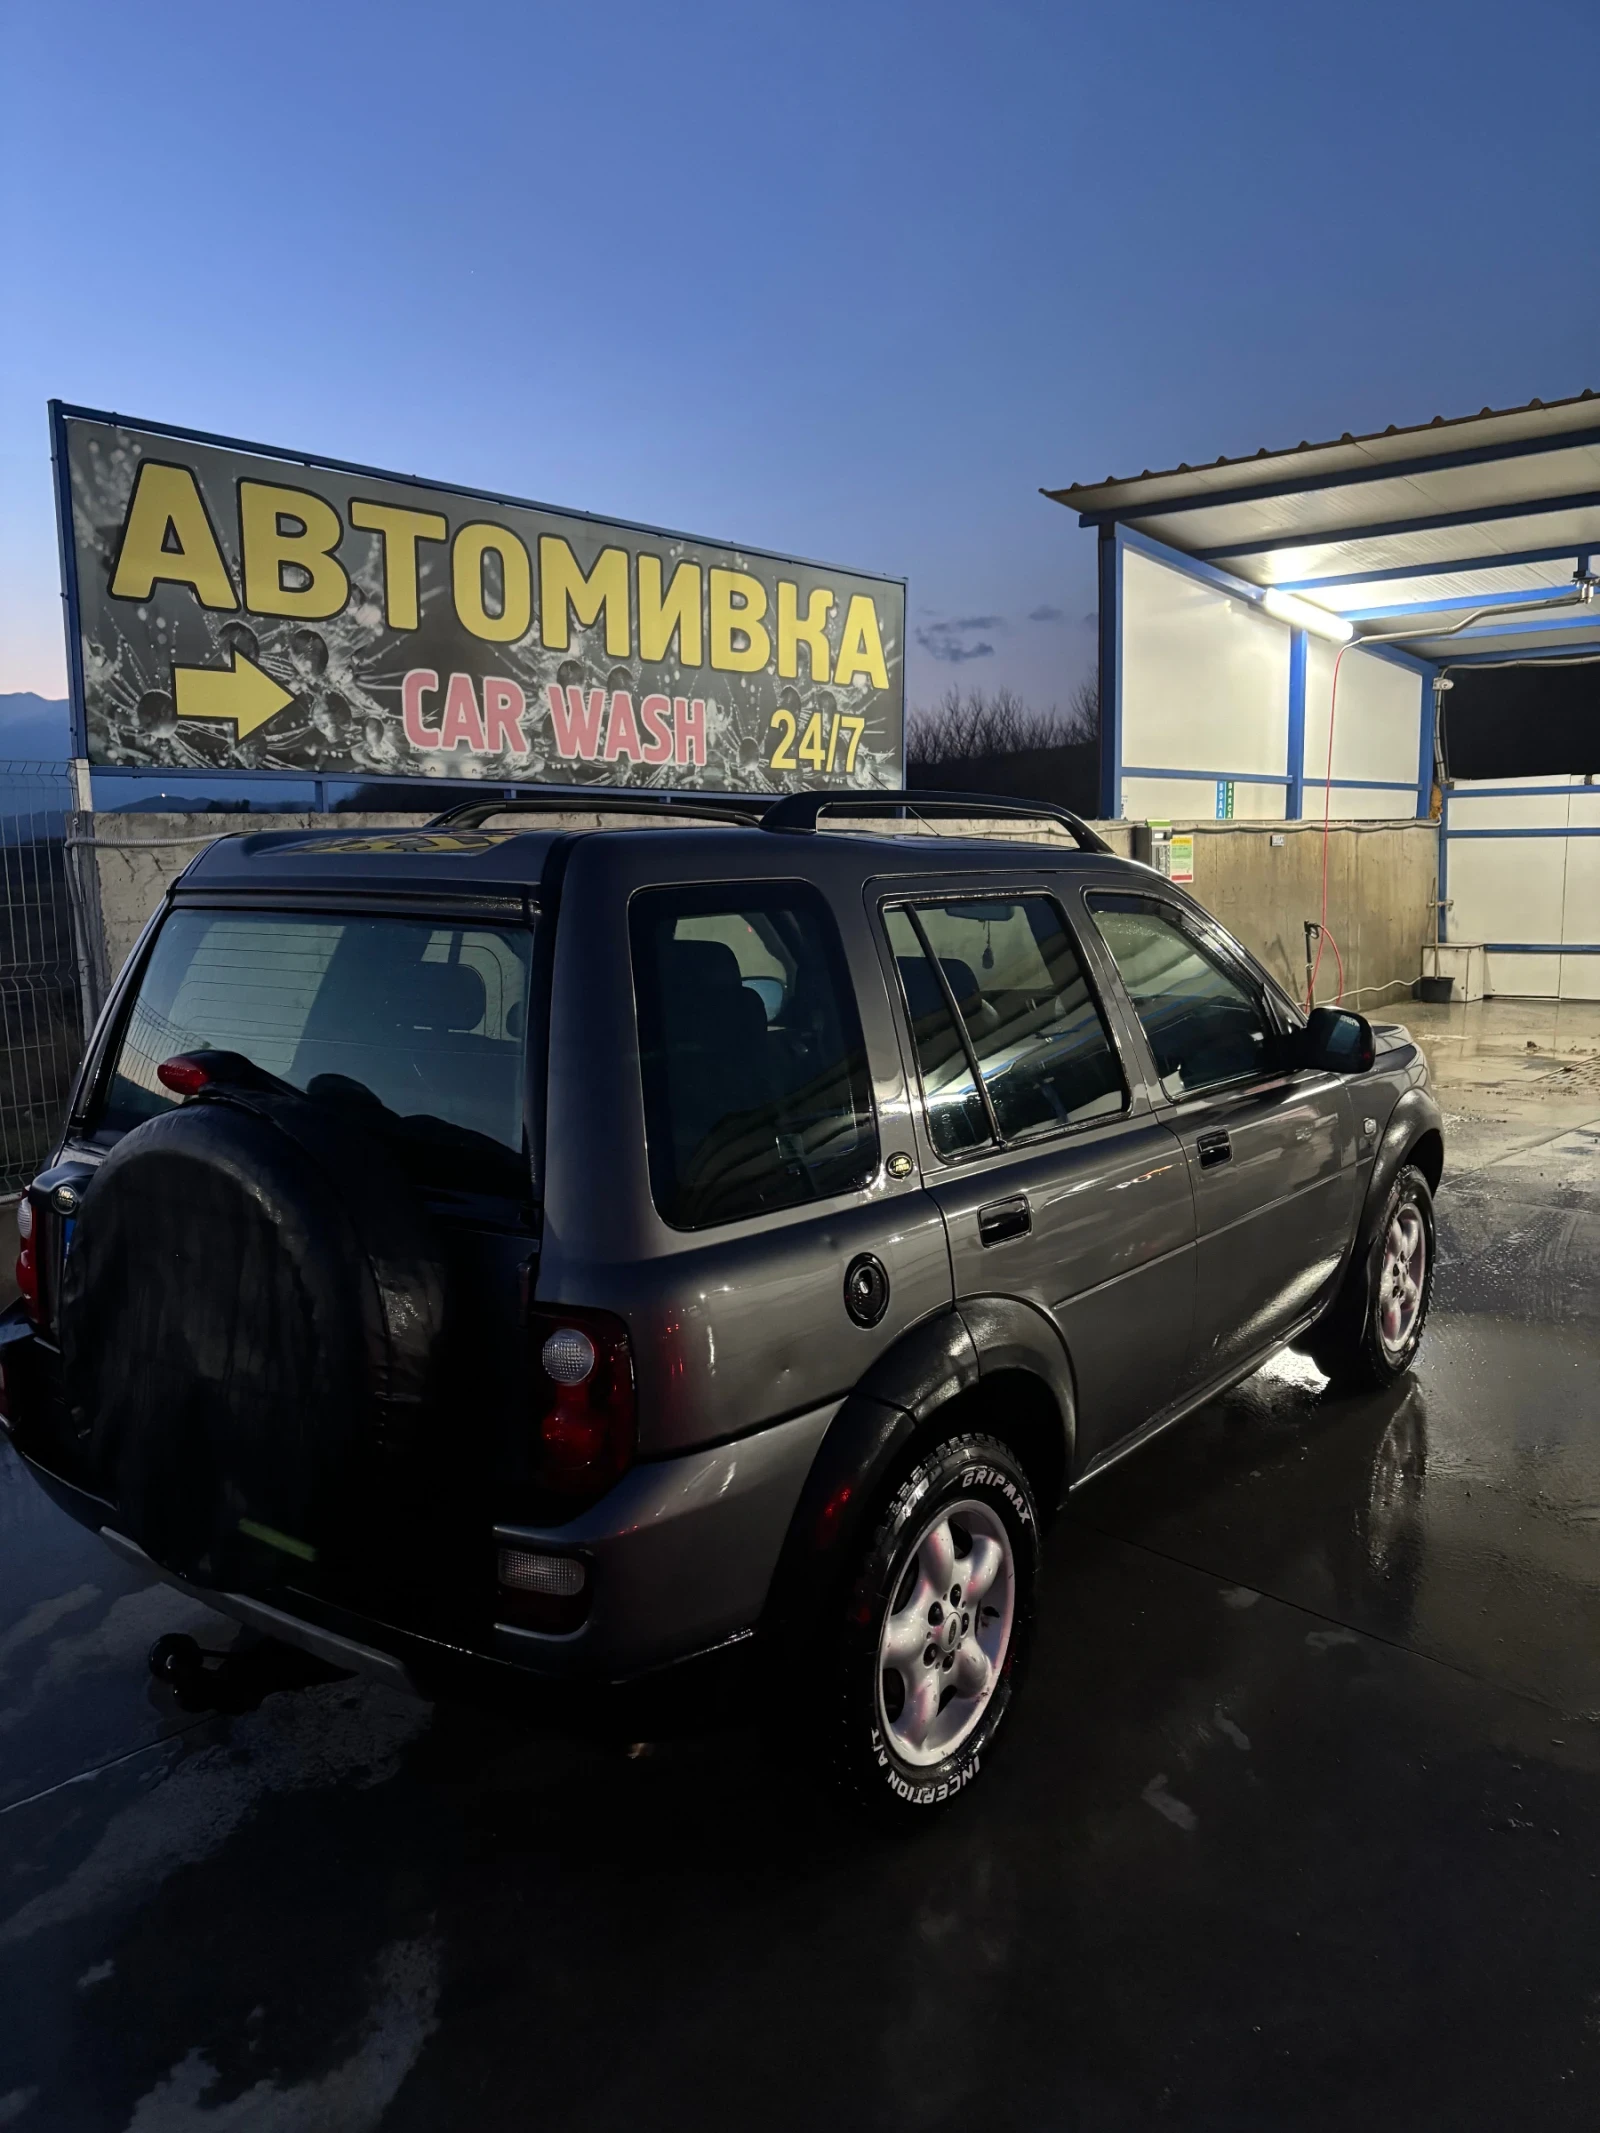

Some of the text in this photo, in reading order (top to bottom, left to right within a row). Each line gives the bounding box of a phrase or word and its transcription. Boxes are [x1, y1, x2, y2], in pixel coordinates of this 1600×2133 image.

[107, 458, 890, 690] АВТОМИВКА
[402, 668, 706, 767] CAR WASH
[770, 709, 865, 773] 24/7
[962, 1470, 1031, 1525] GRIPMAX
[887, 1755, 981, 1804] INCEPTION
